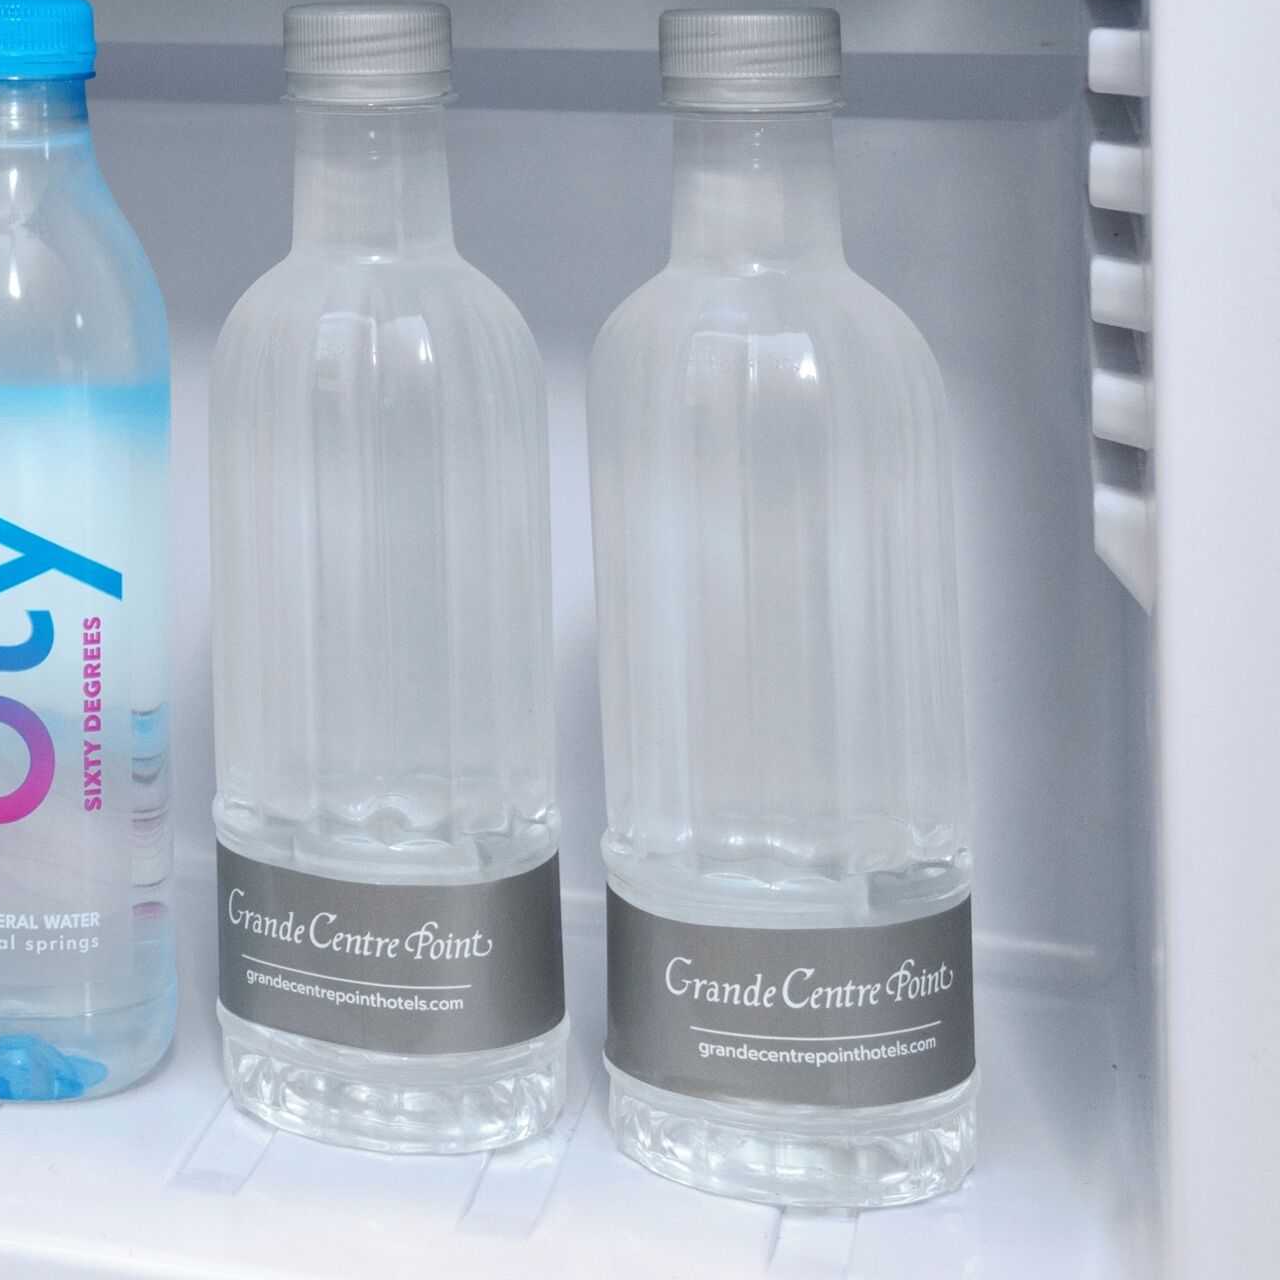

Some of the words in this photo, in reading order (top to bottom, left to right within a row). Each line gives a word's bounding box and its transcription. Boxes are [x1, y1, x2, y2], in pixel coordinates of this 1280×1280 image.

[83, 615, 102, 733] DEGREES
[83, 739, 102, 813] SIXTY
[24, 934, 100, 955] springs
[43, 911, 101, 931] WATER
[227, 886, 306, 945] Grande
[308, 911, 400, 959] Centre
[403, 920, 493, 961] Point
[245, 968, 464, 1011] grandecentrepointhotels.com
[664, 955, 777, 1009] Grande
[781, 967, 881, 1010] Centre
[885, 958, 954, 1003] Point
[698, 1035, 937, 1068] grandecentrepointhotels.com
